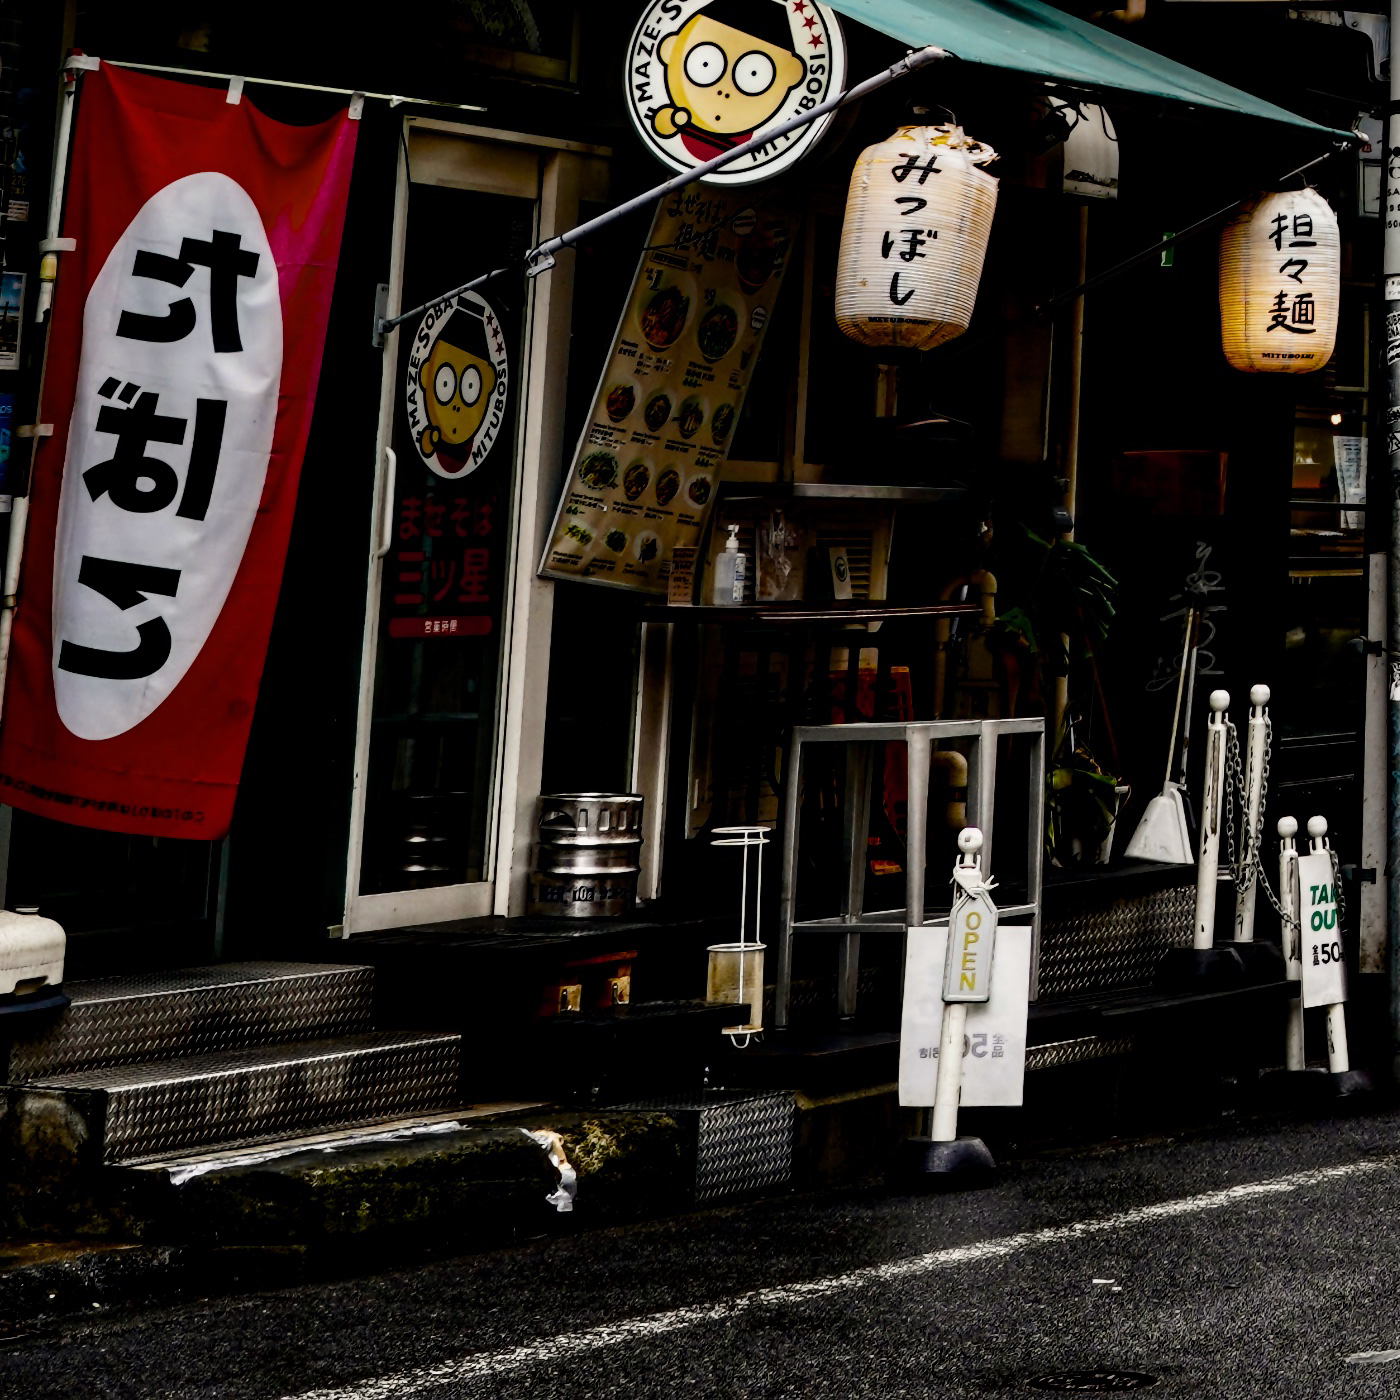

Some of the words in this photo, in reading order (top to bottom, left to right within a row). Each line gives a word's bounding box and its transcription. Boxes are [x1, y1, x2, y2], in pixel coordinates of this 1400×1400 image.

[880, 151, 943, 307] みつぼし
[408, 297, 455, 426] MAZE-SOBA
[471, 358, 507, 466] MITUBOSI
[393, 547, 491, 605] 三ツ星
[958, 911, 983, 992] OPEN
